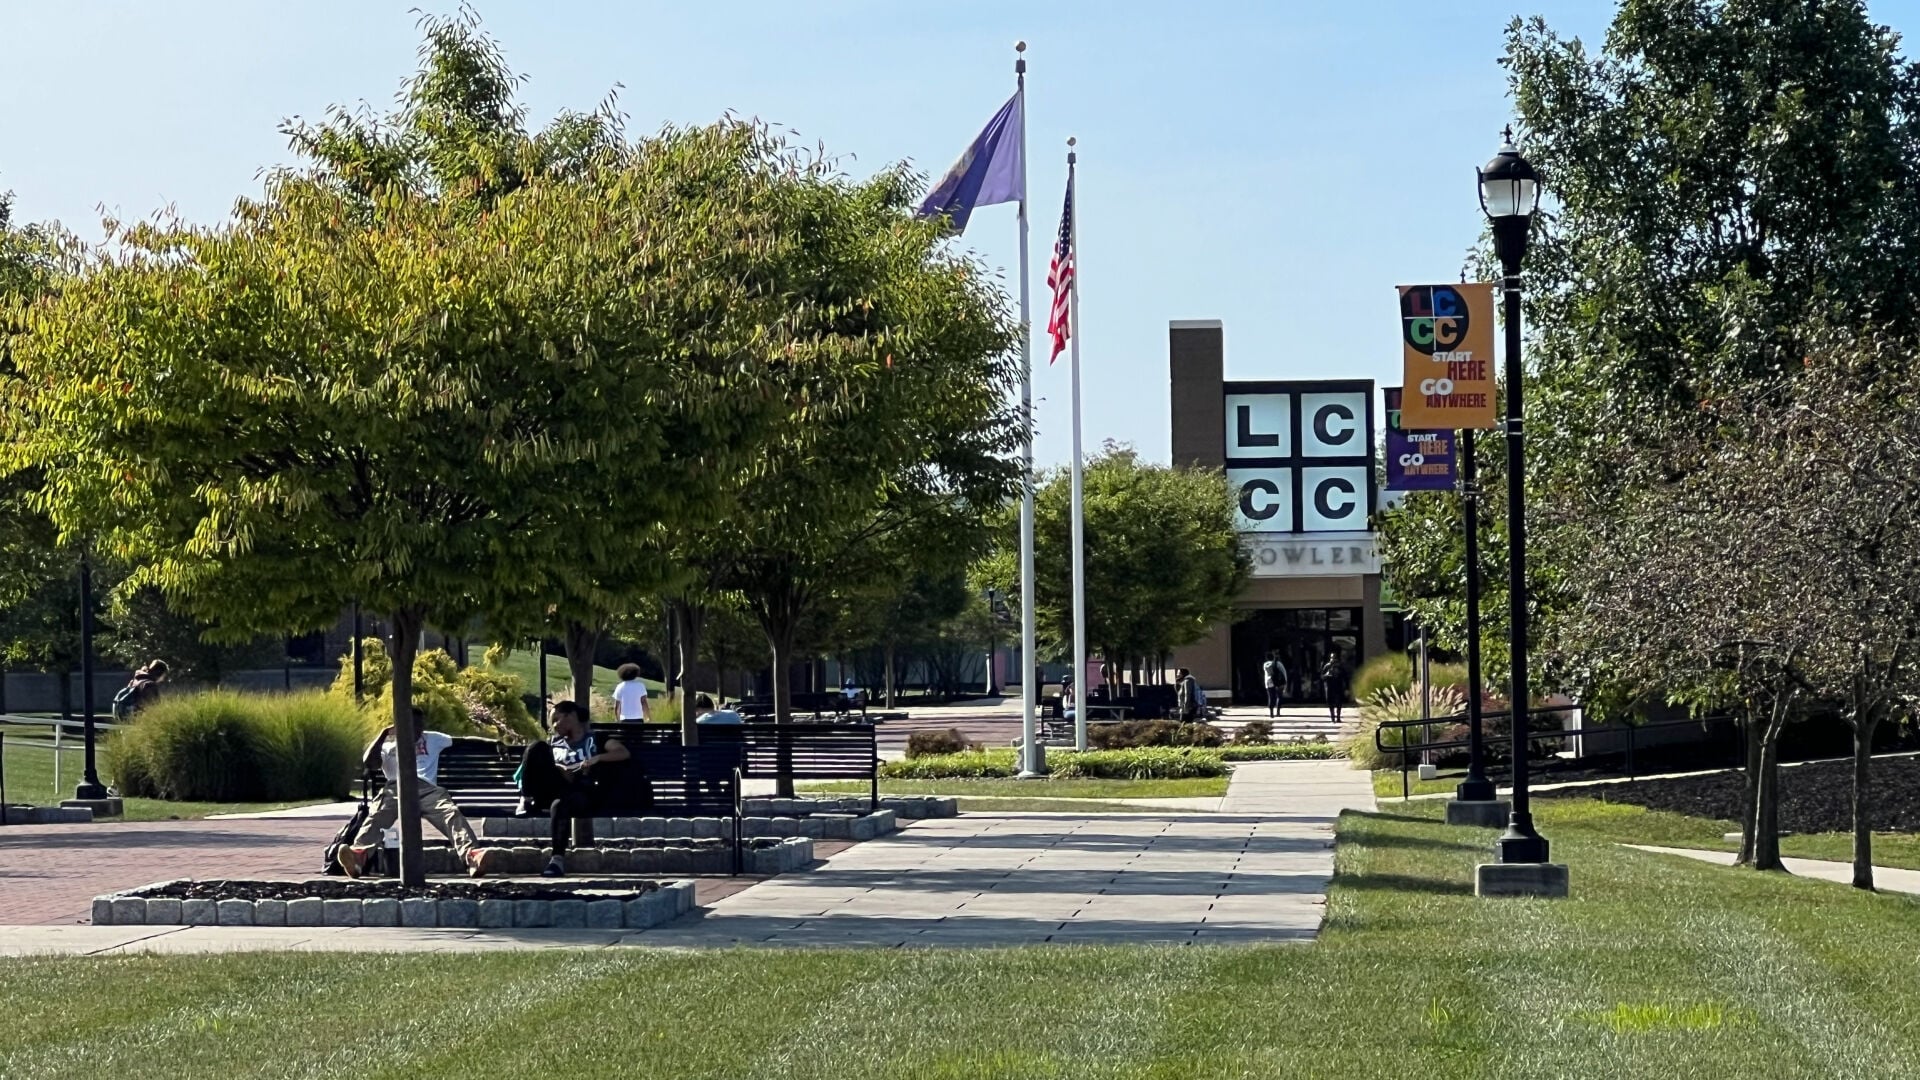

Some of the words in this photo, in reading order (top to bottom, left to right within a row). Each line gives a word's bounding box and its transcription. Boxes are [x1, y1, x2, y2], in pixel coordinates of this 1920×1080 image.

[1432, 351, 1472, 362] START
[1447, 360, 1486, 380] HERE
[1420, 378, 1454, 396] GO
[1426, 393, 1487, 408] ANYWHERE
[1407, 433, 1438, 443] START
[1419, 440, 1449, 456] HERE
[1399, 453, 1425, 467] GO
[1404, 463, 1449, 476] ANYWHERE
[1260, 546, 1364, 565] OWLER
